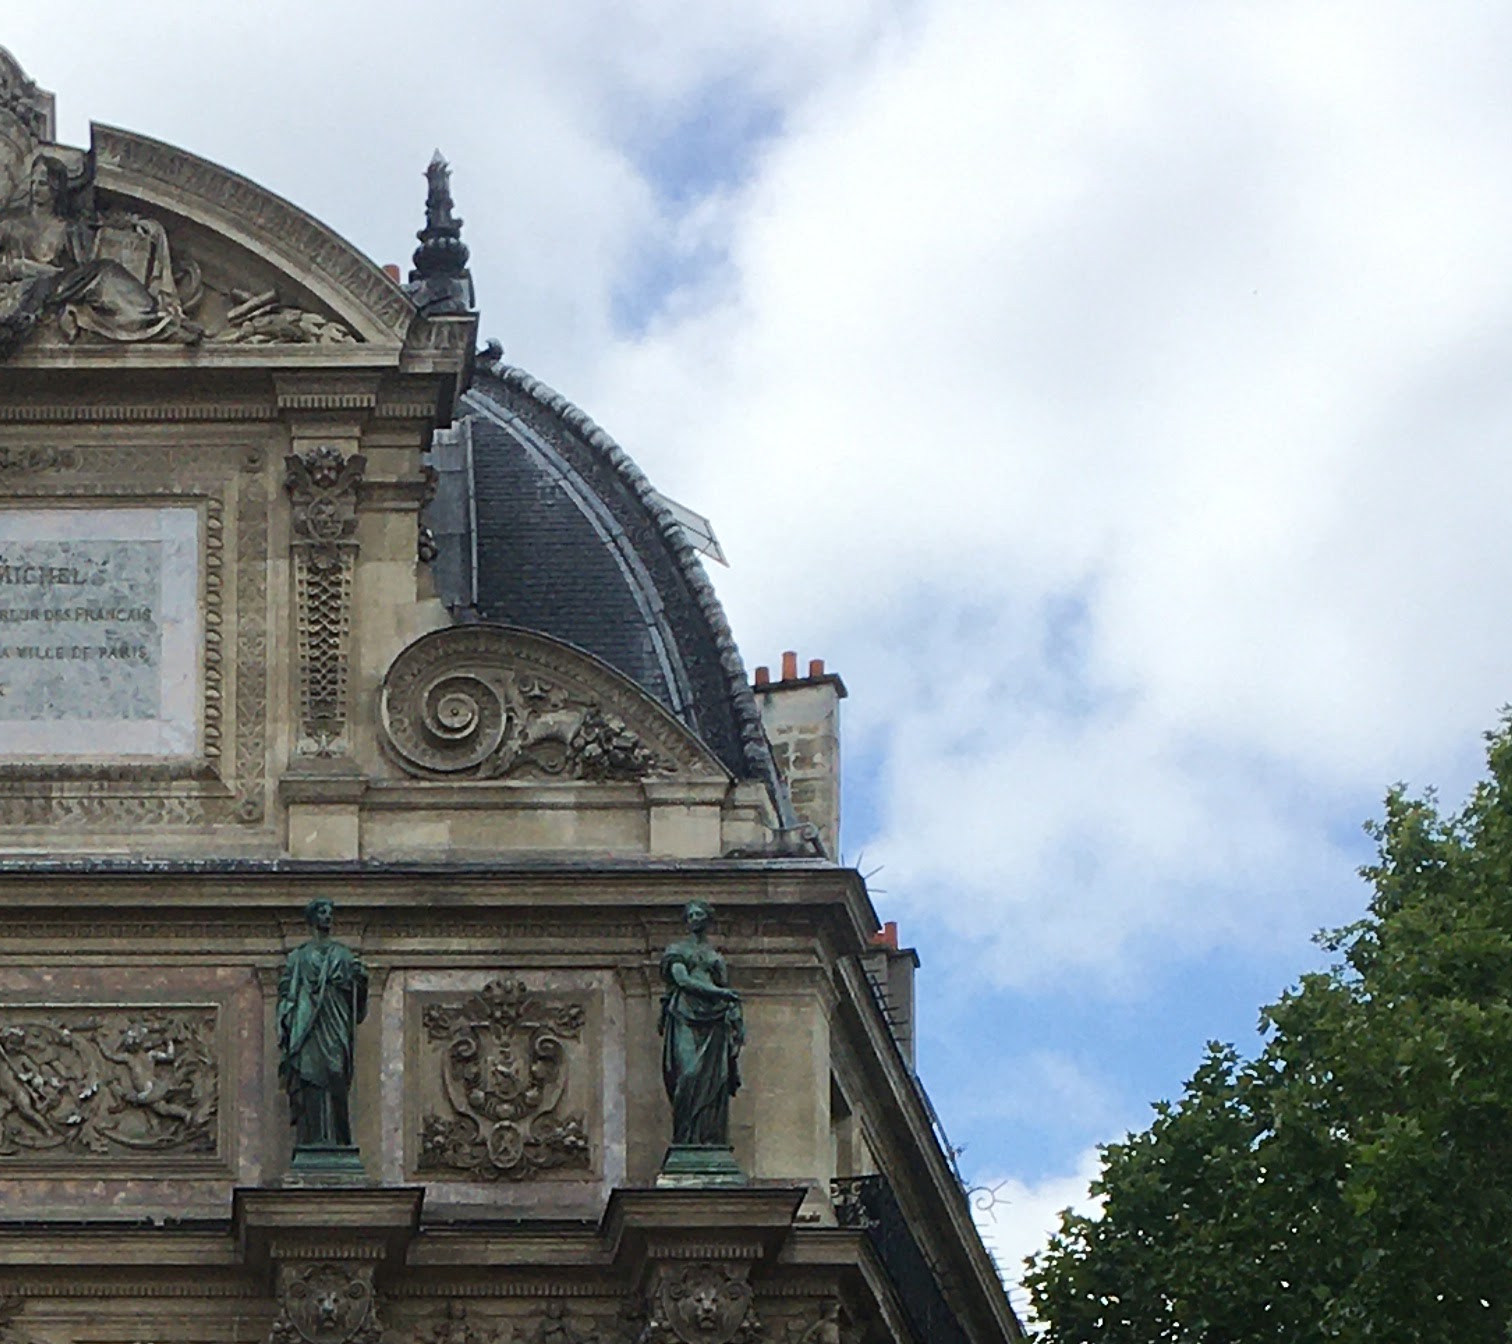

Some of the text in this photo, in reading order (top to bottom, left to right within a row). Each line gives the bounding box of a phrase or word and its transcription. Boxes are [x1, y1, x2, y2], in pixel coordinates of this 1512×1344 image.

[43, 608, 71, 622] DES
[16, 645, 65, 660] VILLE
[71, 645, 91, 660] DE
[98, 644, 149, 660] PARIS
